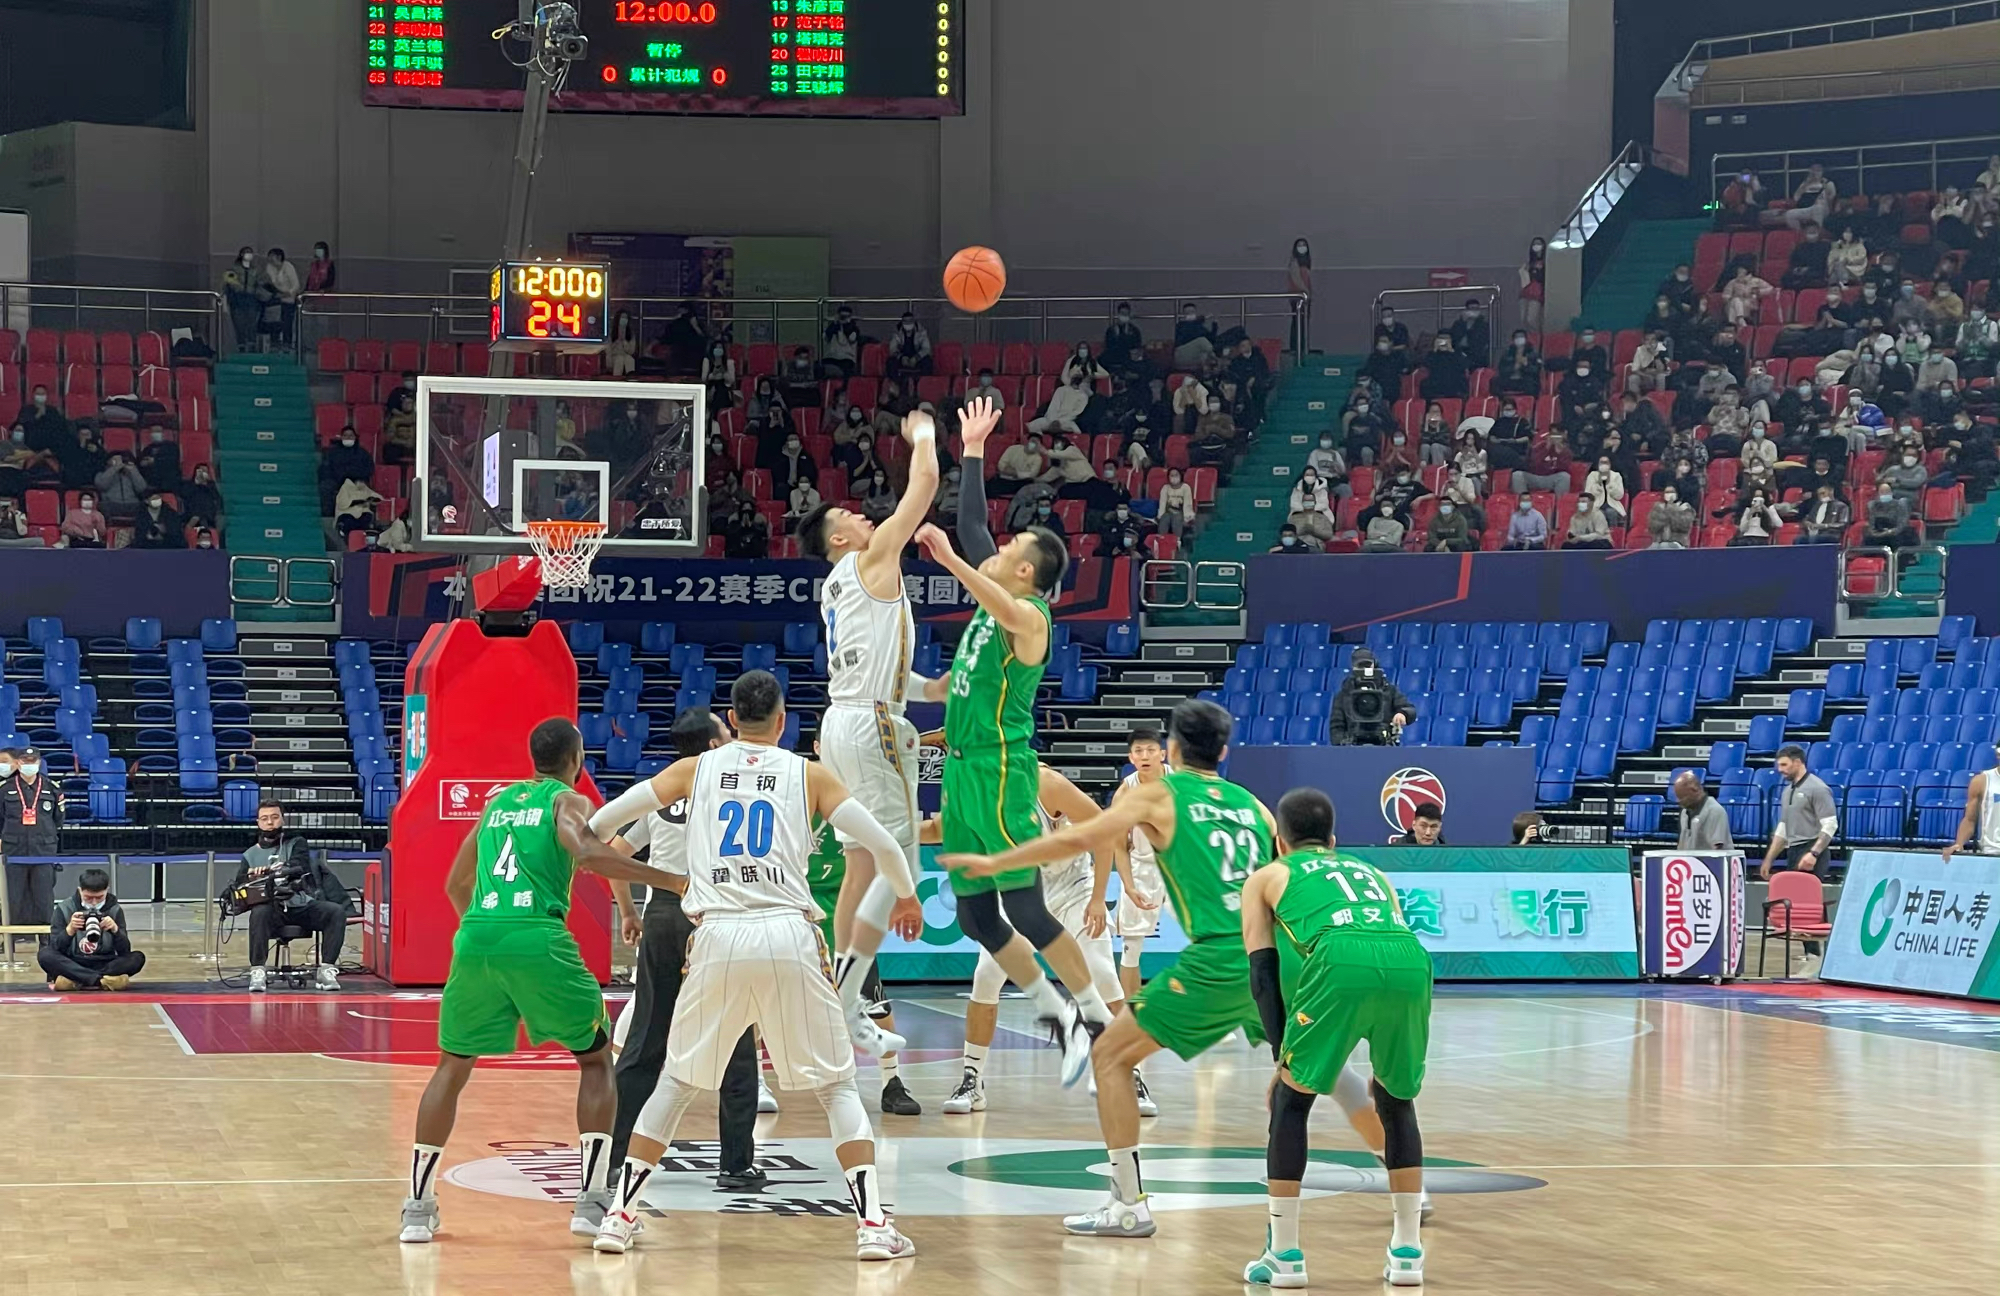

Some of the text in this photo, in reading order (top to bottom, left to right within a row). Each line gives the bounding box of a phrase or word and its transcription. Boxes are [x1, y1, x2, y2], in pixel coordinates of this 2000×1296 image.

[369, 6, 384, 18] 21
[615, 1, 716, 22] 12:00.0
[938, 3, 948, 14] 0
[369, 22, 386, 34] 22
[772, 16, 788, 27] 17
[938, 19, 948, 30] 0
[772, 32, 788, 44] 19
[938, 35, 948, 46] 0
[369, 39, 386, 51] 25
[771, 49, 788, 60] 20
[938, 51, 948, 63] 0
[369, 55, 387, 68] 36
[602, 66, 617, 82] 0
[629, 67, 700, 83] 累计犯规
[712, 68, 727, 84] 0
[771, 65, 788, 76] 25
[938, 67, 948, 79] 0
[771, 81, 788, 92] 33
[938, 83, 948, 95] 0
[527, 301, 580, 337] 24
[720, 771, 777, 792] 首钢
[717, 800, 775, 858] 20
[491, 831, 520, 883] 4
[1208, 828, 1260, 882] 22
[821, 864, 833, 880] 7
[1324, 870, 1389, 902] 13
[1692, 873, 1713, 944] 百岁山
[1902, 885, 1991, 931] 中国人寿
[1894, 931, 1979, 959] CHINA LIFE
